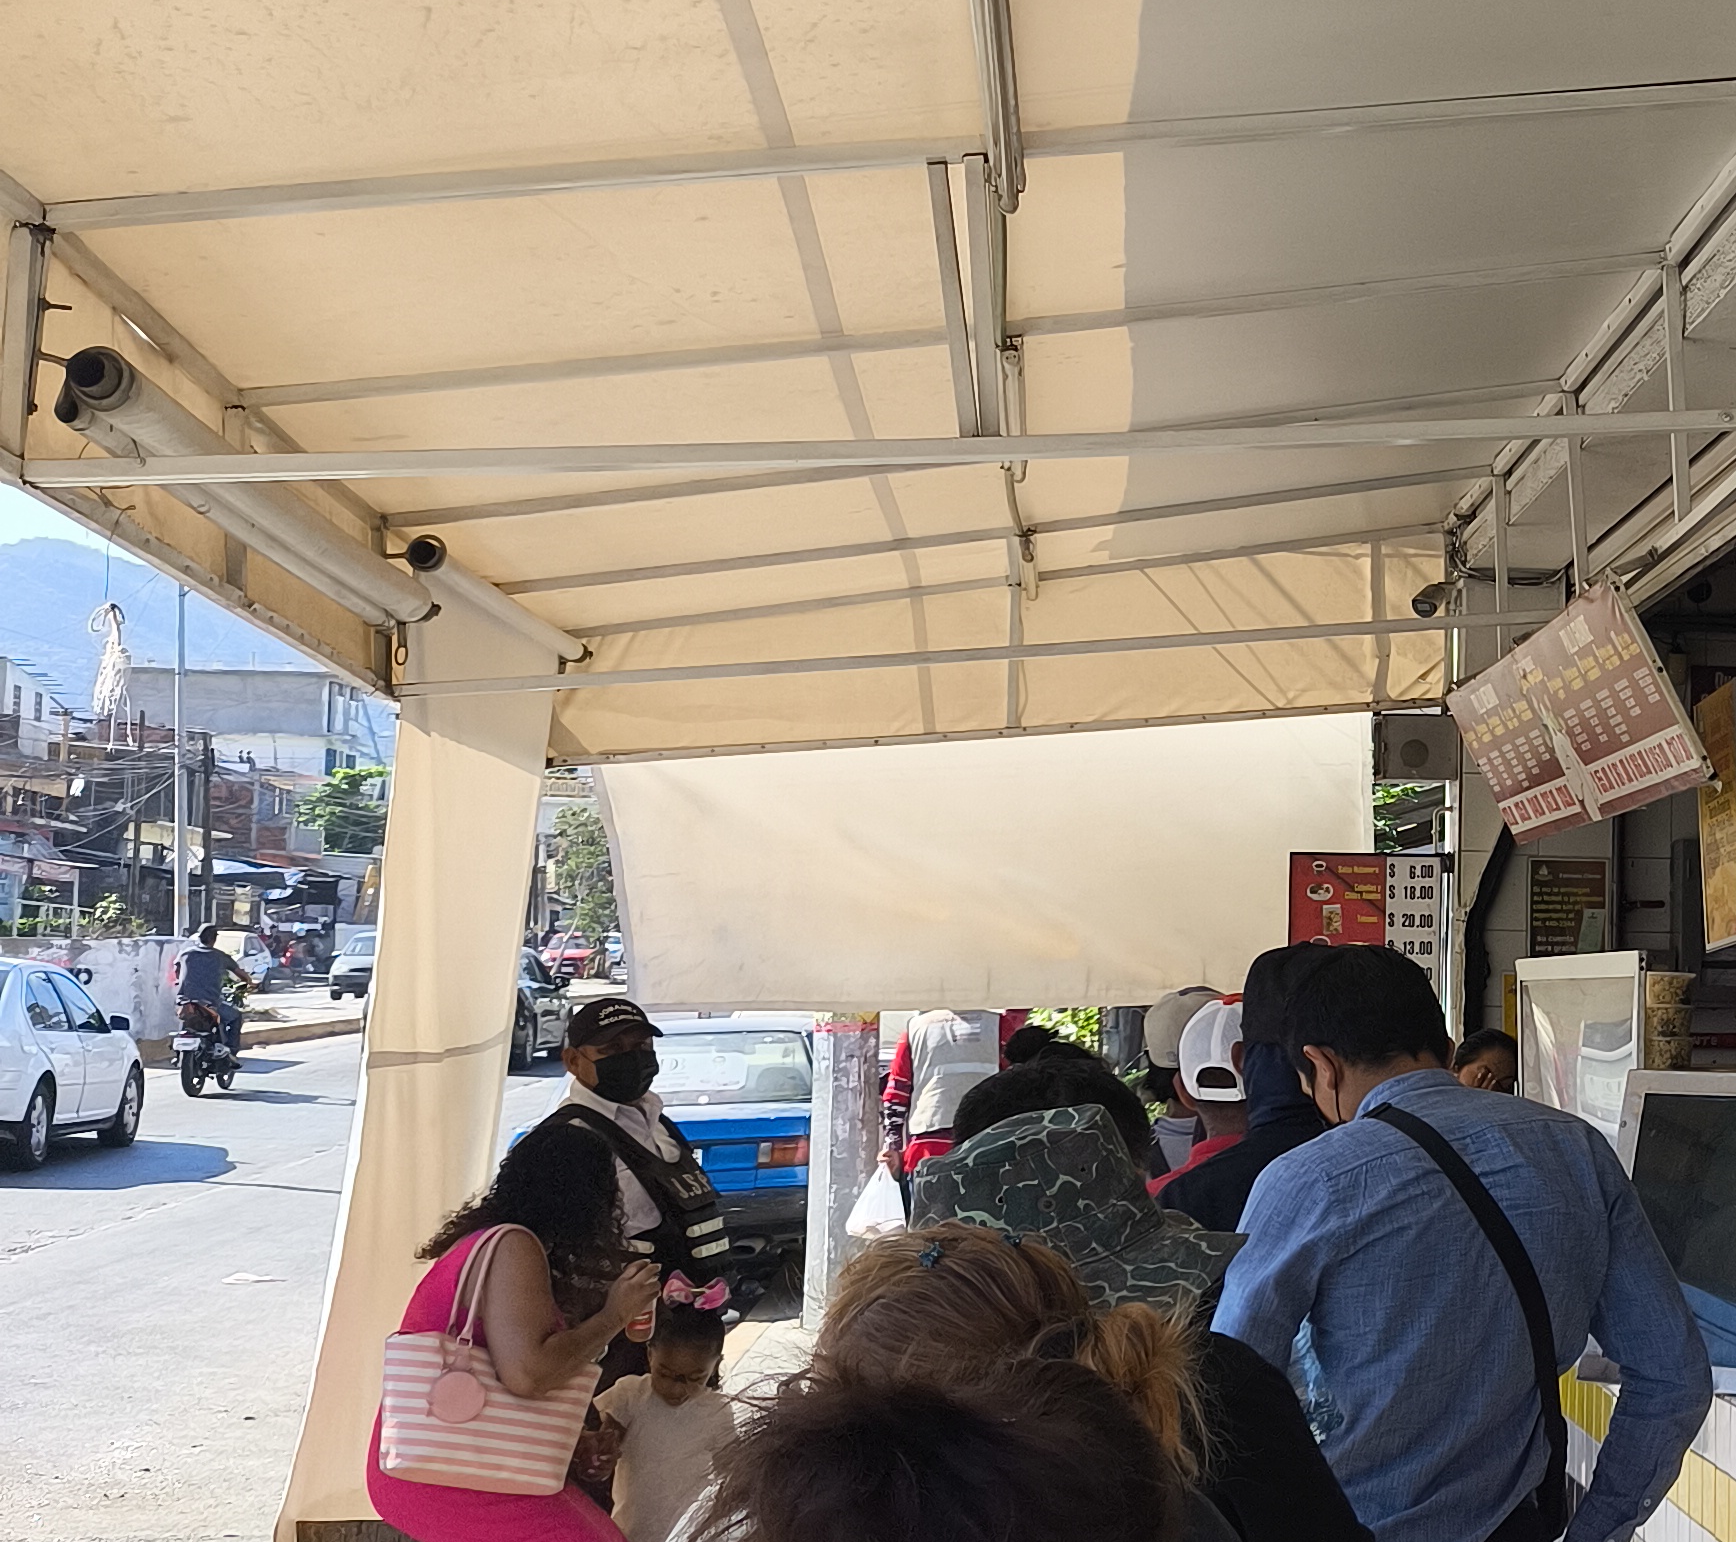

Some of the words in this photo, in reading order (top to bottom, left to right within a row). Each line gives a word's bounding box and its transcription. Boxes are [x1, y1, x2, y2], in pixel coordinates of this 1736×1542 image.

[1388, 863, 1396, 879] $
[1409, 865, 1434, 879] 6.00
[1388, 884, 1396, 900] $
[1403, 885, 1434, 900] 18.00
[1387, 912, 1396, 928] $
[1401, 913, 1434, 929] 20.00
